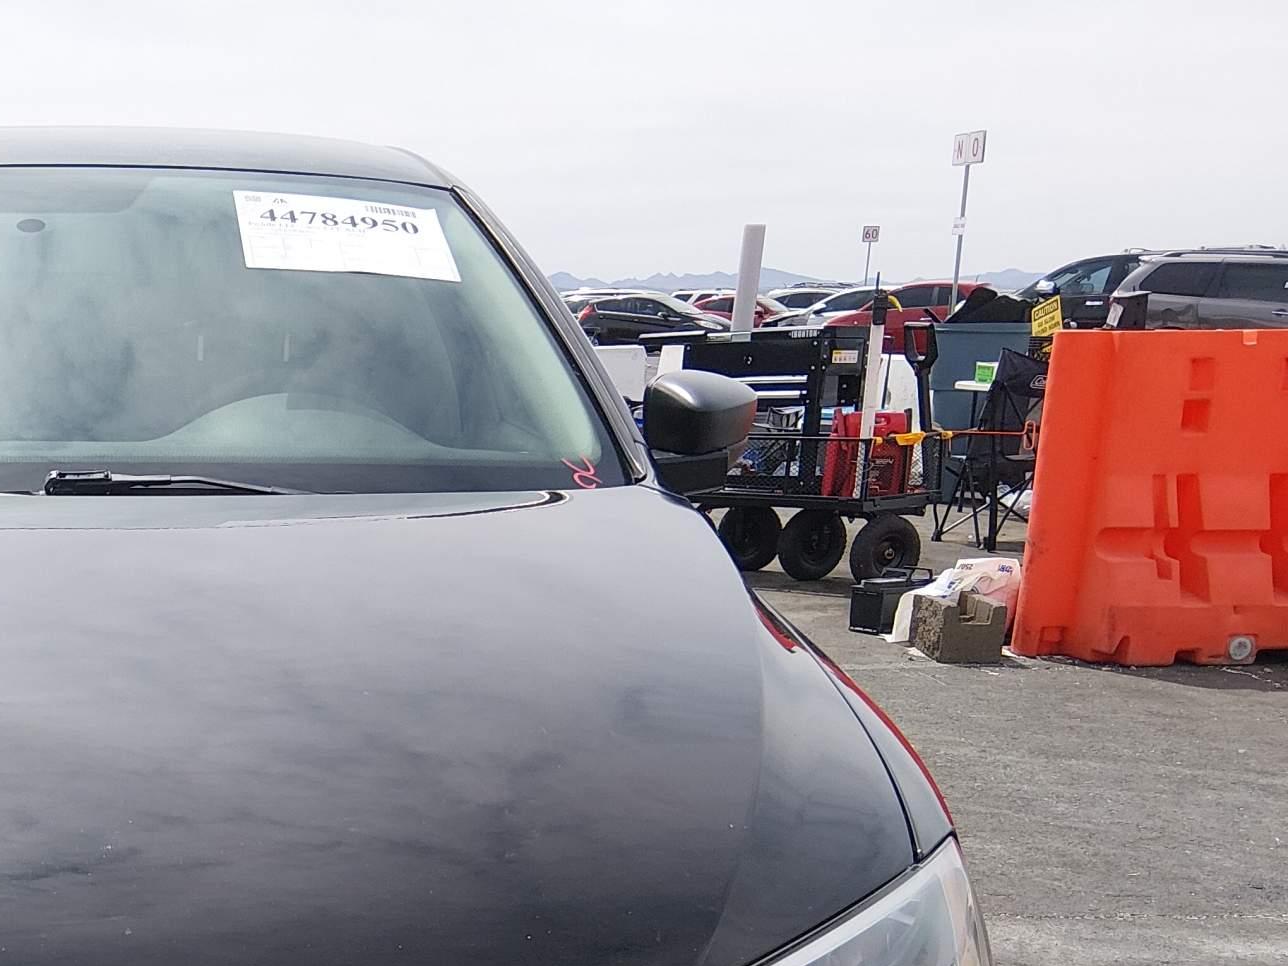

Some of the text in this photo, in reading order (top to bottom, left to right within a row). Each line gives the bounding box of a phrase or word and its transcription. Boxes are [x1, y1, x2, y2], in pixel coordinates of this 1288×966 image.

[259, 208, 419, 235] 44784950
[864, 228, 878, 240] 60
[1034, 300, 1058, 319] CAUTION
